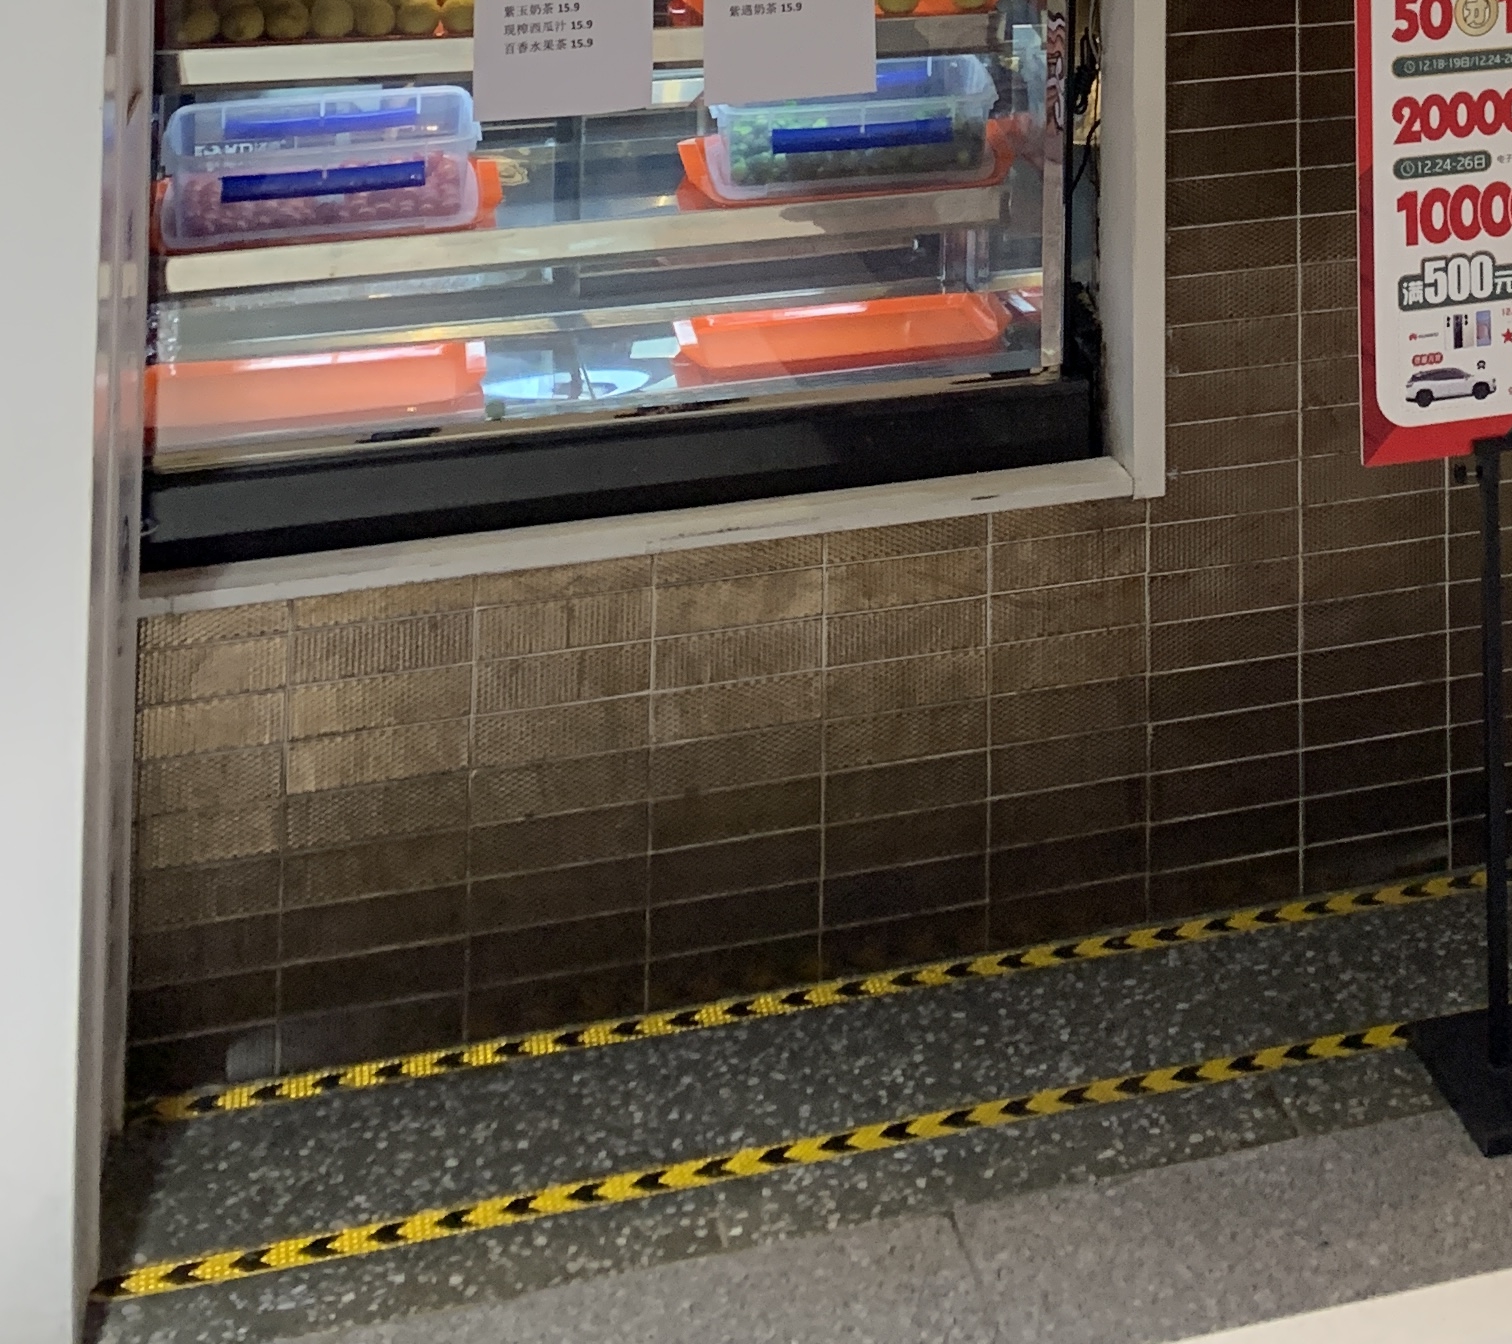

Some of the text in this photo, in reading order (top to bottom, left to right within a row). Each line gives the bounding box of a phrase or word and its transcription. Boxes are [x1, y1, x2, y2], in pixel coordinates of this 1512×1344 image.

[558, 2, 580, 13] 15.9
[781, 2, 803, 13] 15.9
[571, 19, 593, 30] 15.9
[571, 38, 594, 49] 15.9
[1416, 154, 1487, 175] 12.24-26日
